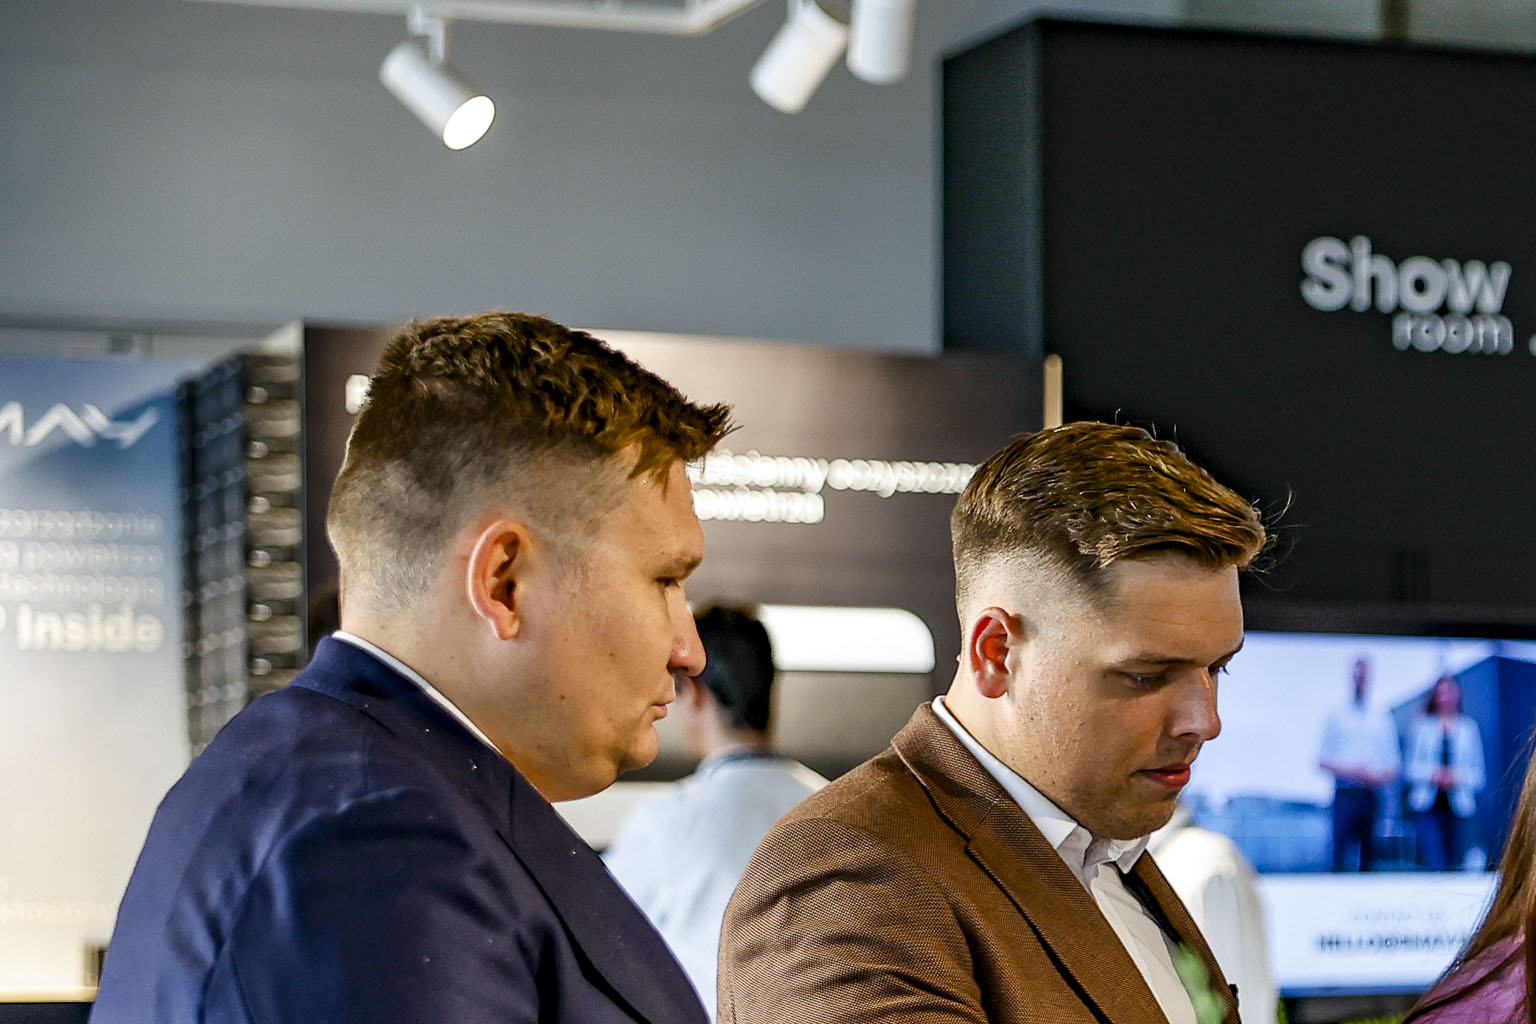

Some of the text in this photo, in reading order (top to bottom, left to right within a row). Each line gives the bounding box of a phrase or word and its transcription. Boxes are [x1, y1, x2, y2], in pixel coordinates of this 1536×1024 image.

[1301, 235, 1512, 314] Show
[1392, 312, 1514, 355] room
[16, 603, 165, 652] Inside
